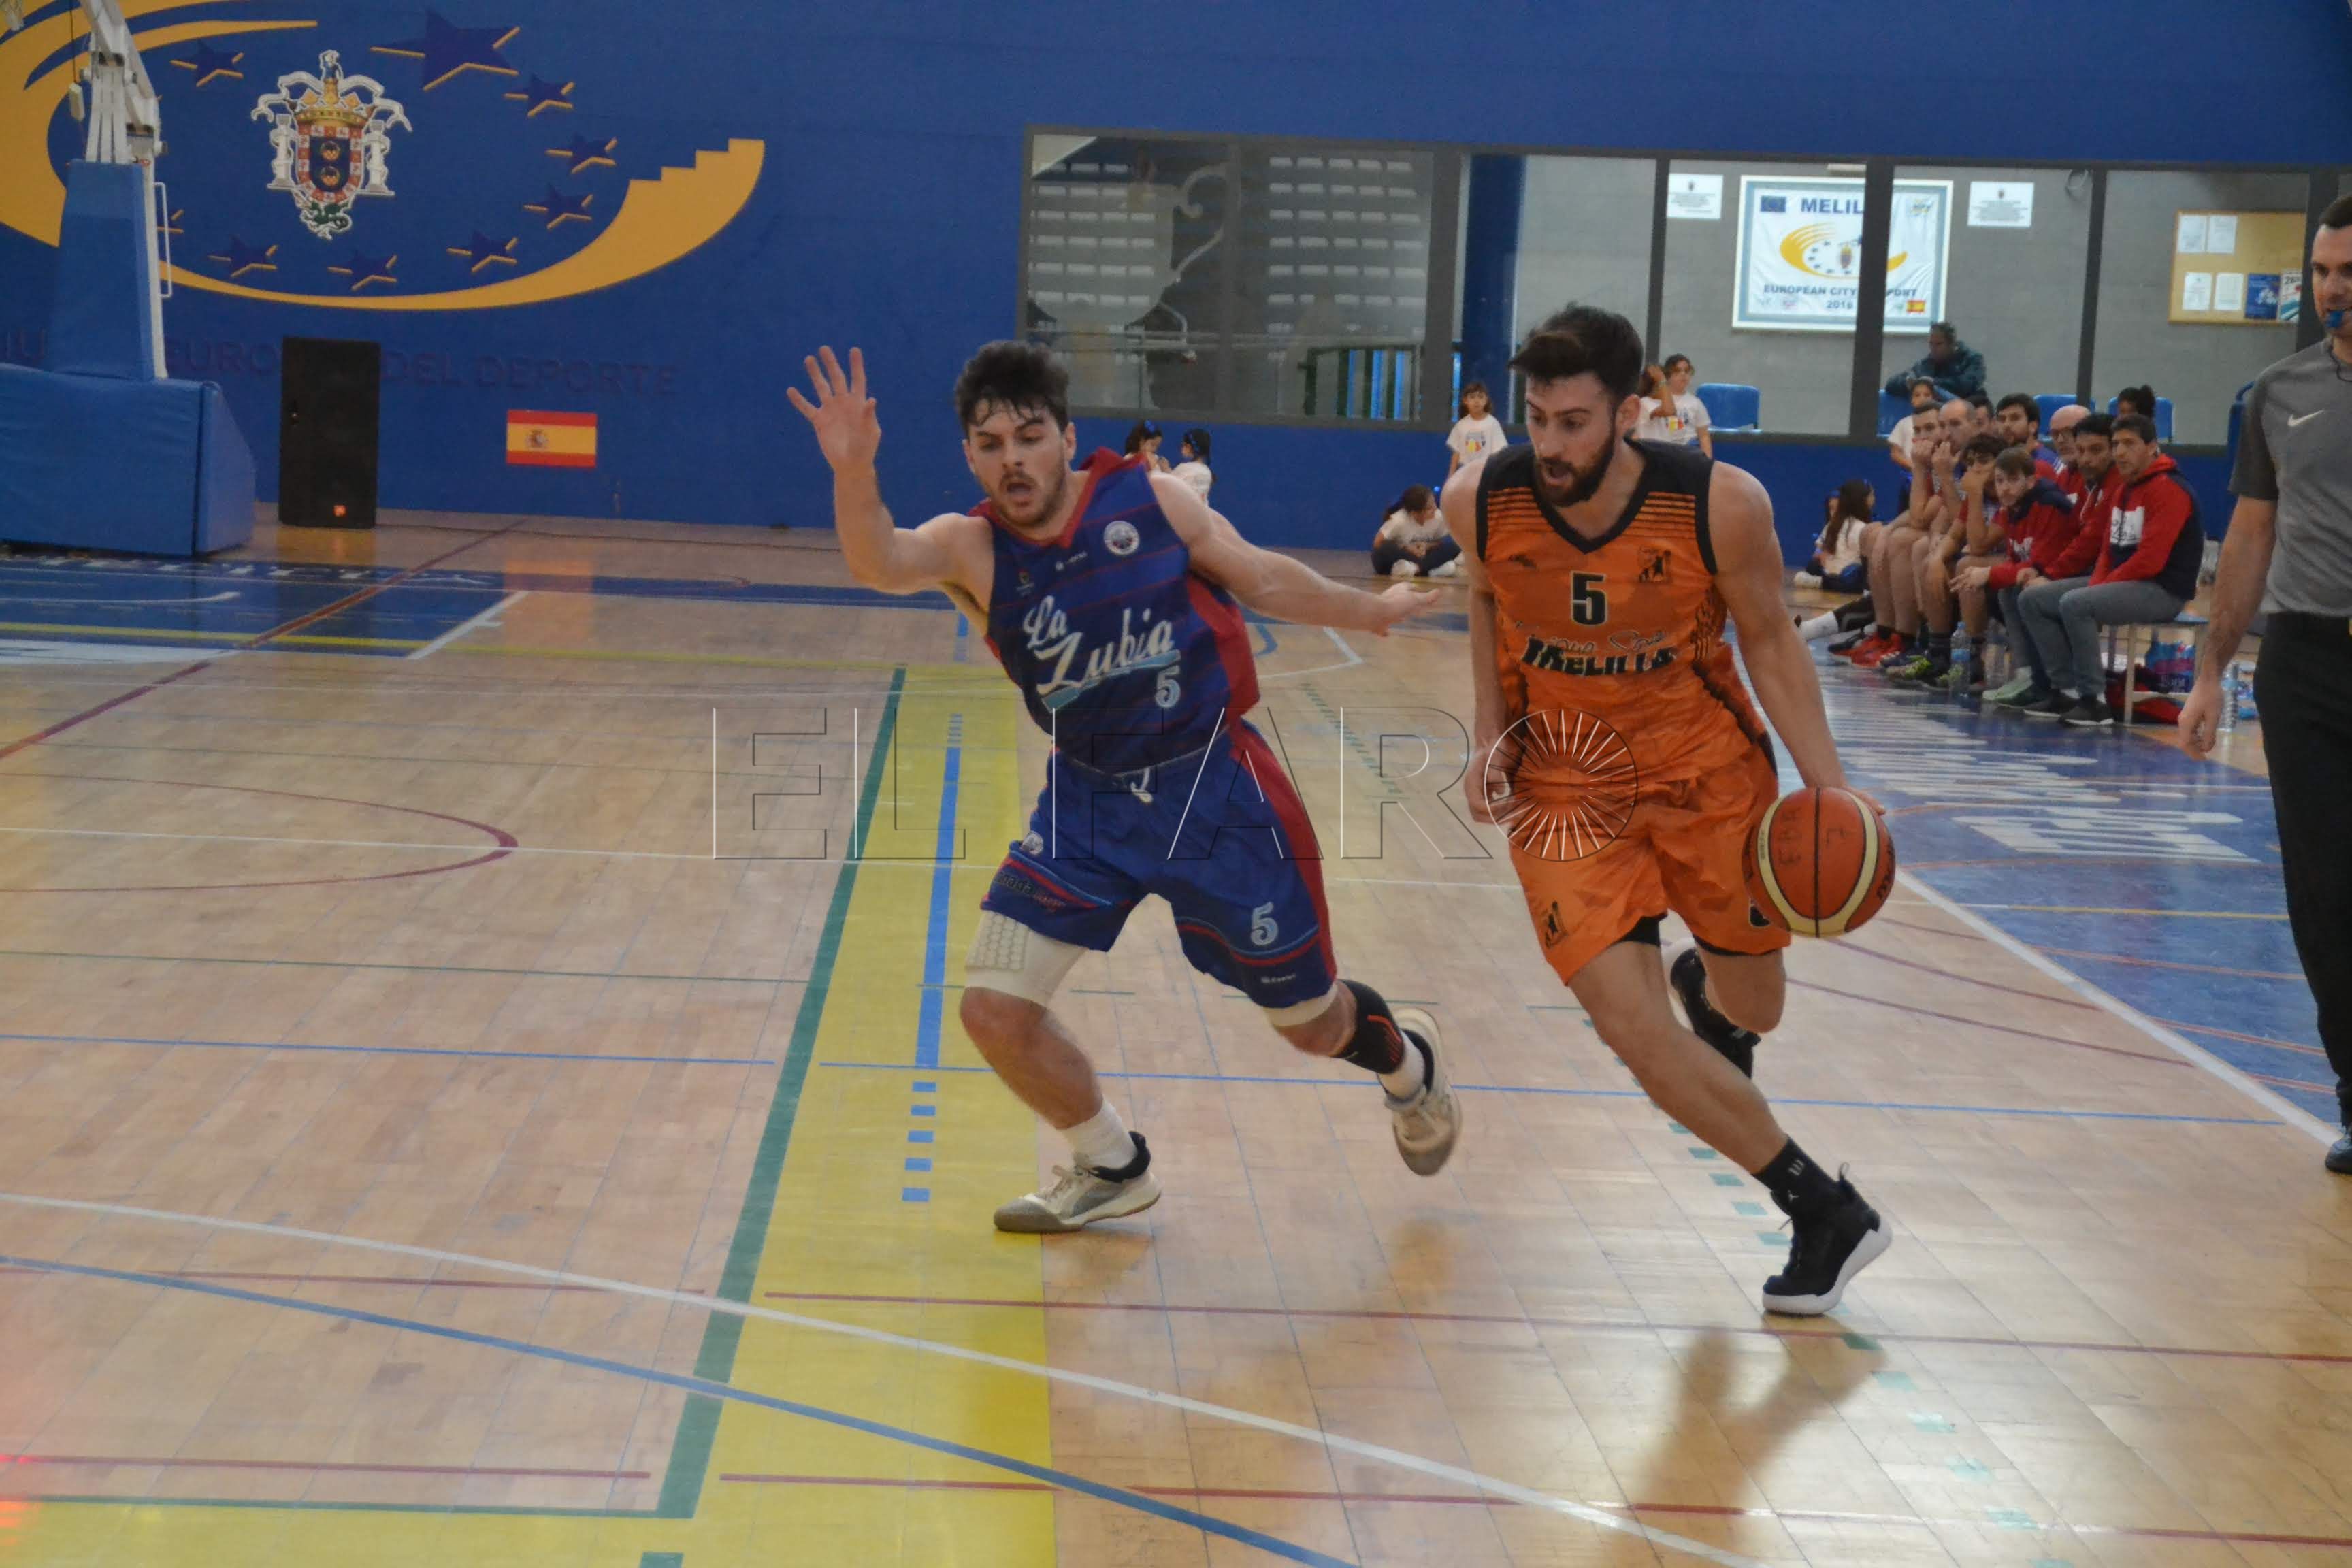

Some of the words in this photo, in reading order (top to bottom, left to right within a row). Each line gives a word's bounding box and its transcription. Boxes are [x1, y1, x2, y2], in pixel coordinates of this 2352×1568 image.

[1801, 198, 1865, 214] MELIL
[1763, 284, 1826, 295] EUROPEAN
[1830, 287, 1857, 296] CITY
[1886, 288, 1917, 297] PORT
[474, 355, 681, 396] DEPORTE
[1571, 570, 1608, 627] 5
[1022, 595, 1067, 650] La
[1034, 607, 1176, 696] Zubia
[1521, 636, 1677, 676] MELILLA
[1155, 665, 1181, 708] 5
[1251, 901, 1279, 945] 5
